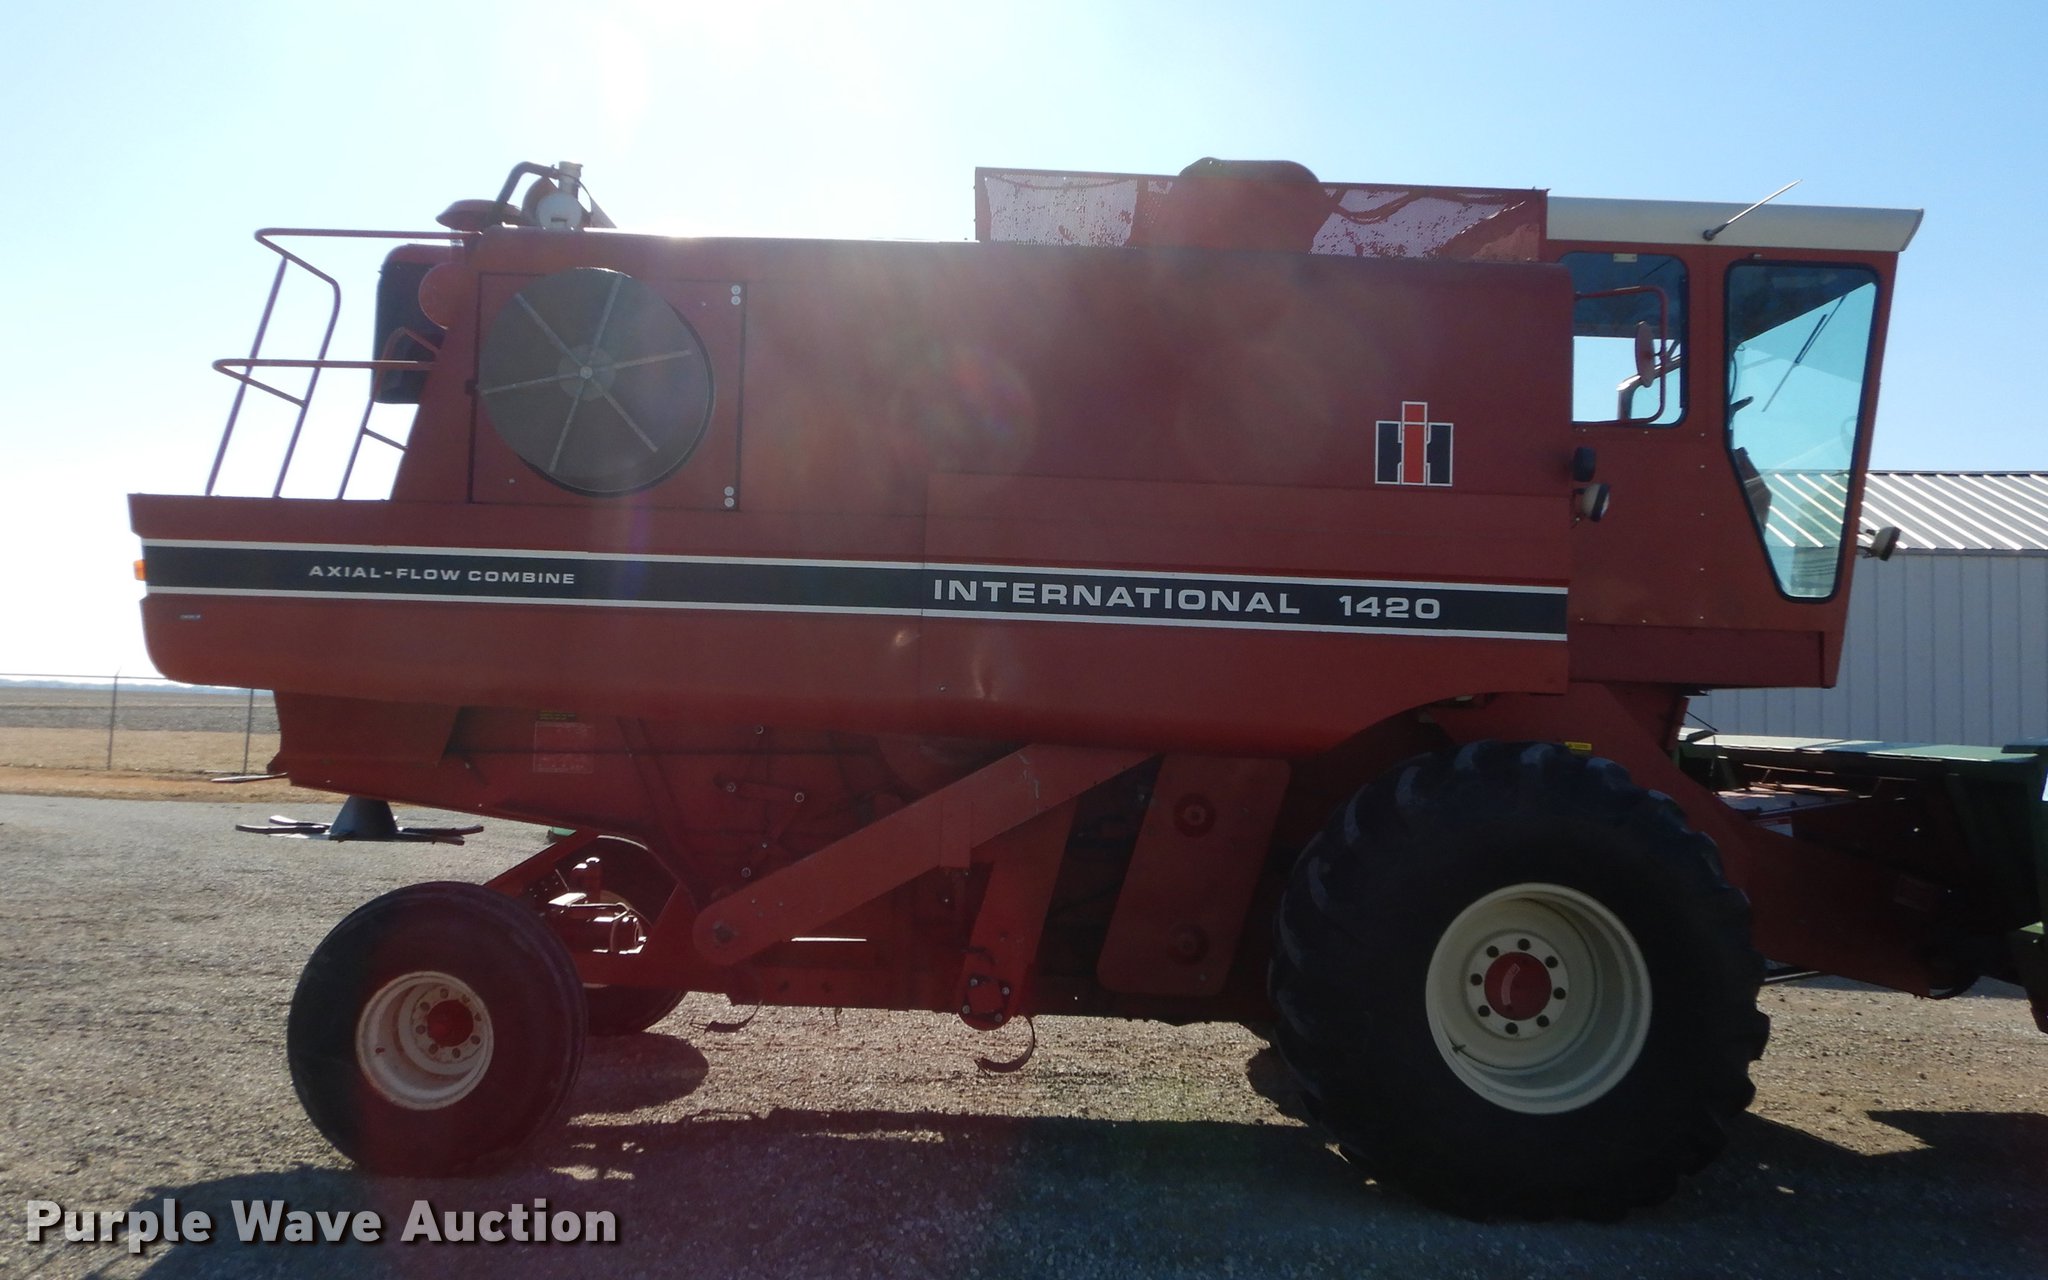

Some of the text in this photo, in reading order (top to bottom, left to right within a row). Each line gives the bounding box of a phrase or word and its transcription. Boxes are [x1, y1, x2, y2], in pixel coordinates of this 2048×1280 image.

[308, 565, 575, 584] AXIAL-FLOW COMBINE
[933, 578, 1441, 620] INTERNATIONAL 1420
